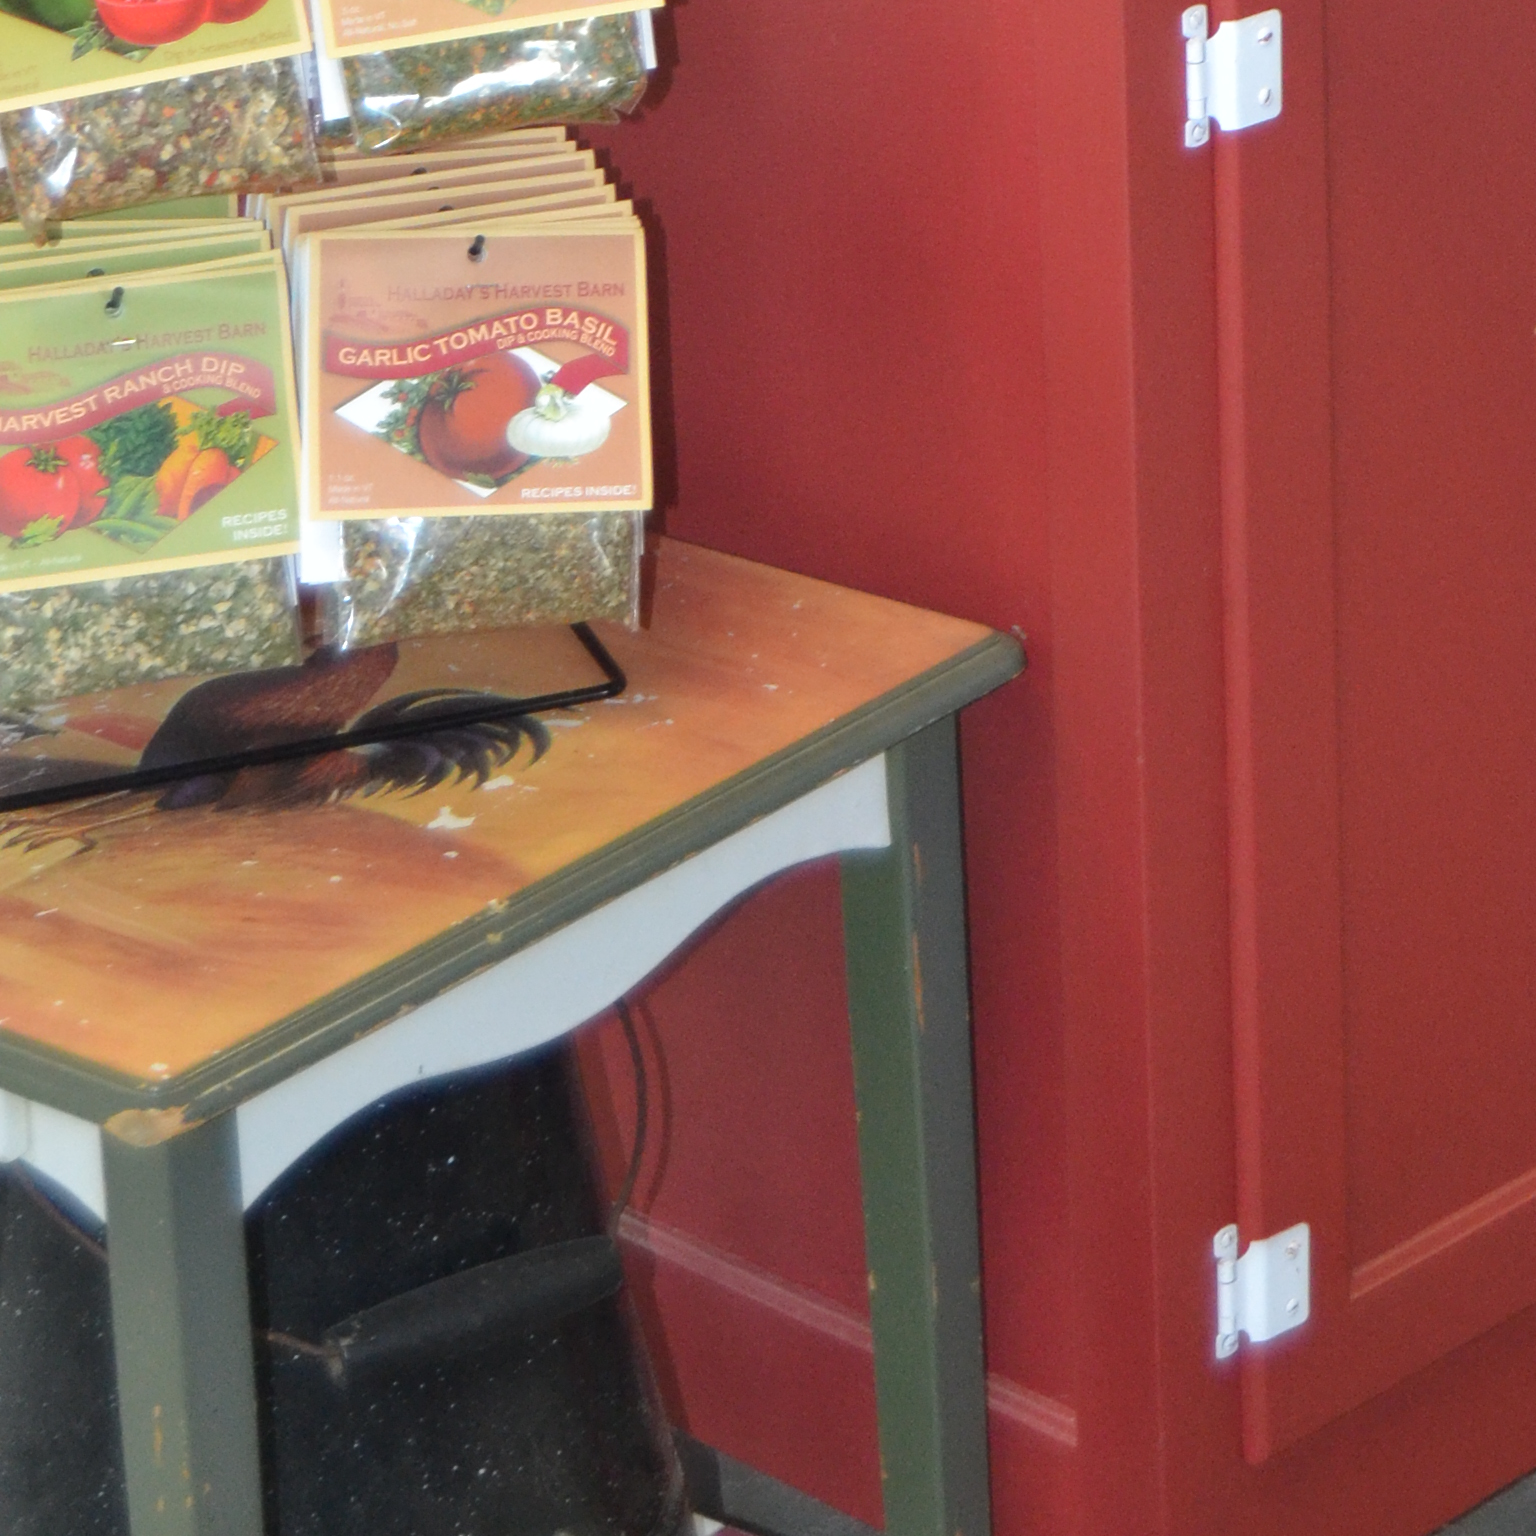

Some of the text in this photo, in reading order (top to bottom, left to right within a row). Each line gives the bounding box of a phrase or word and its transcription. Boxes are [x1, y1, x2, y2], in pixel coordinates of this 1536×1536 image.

[386, 280, 625, 304] HALLADAY'S HARVEST BARN
[27, 321, 266, 364] HALLADAY'S HARVEST BARN
[338, 307, 619, 368] GARLIC TOMATO BASIL
[496, 335, 515, 350] DIP
[527, 328, 579, 343] COOKING
[580, 330, 616, 357] BLEND
[101, 360, 194, 404] RANCH
[200, 357, 246, 378] DIP
[172, 373, 223, 392] COOKING
[225, 375, 261, 400] BLEND
[521, 483, 638, 499] RECIPES INSIDE!
[221, 509, 288, 529] RECIPES
